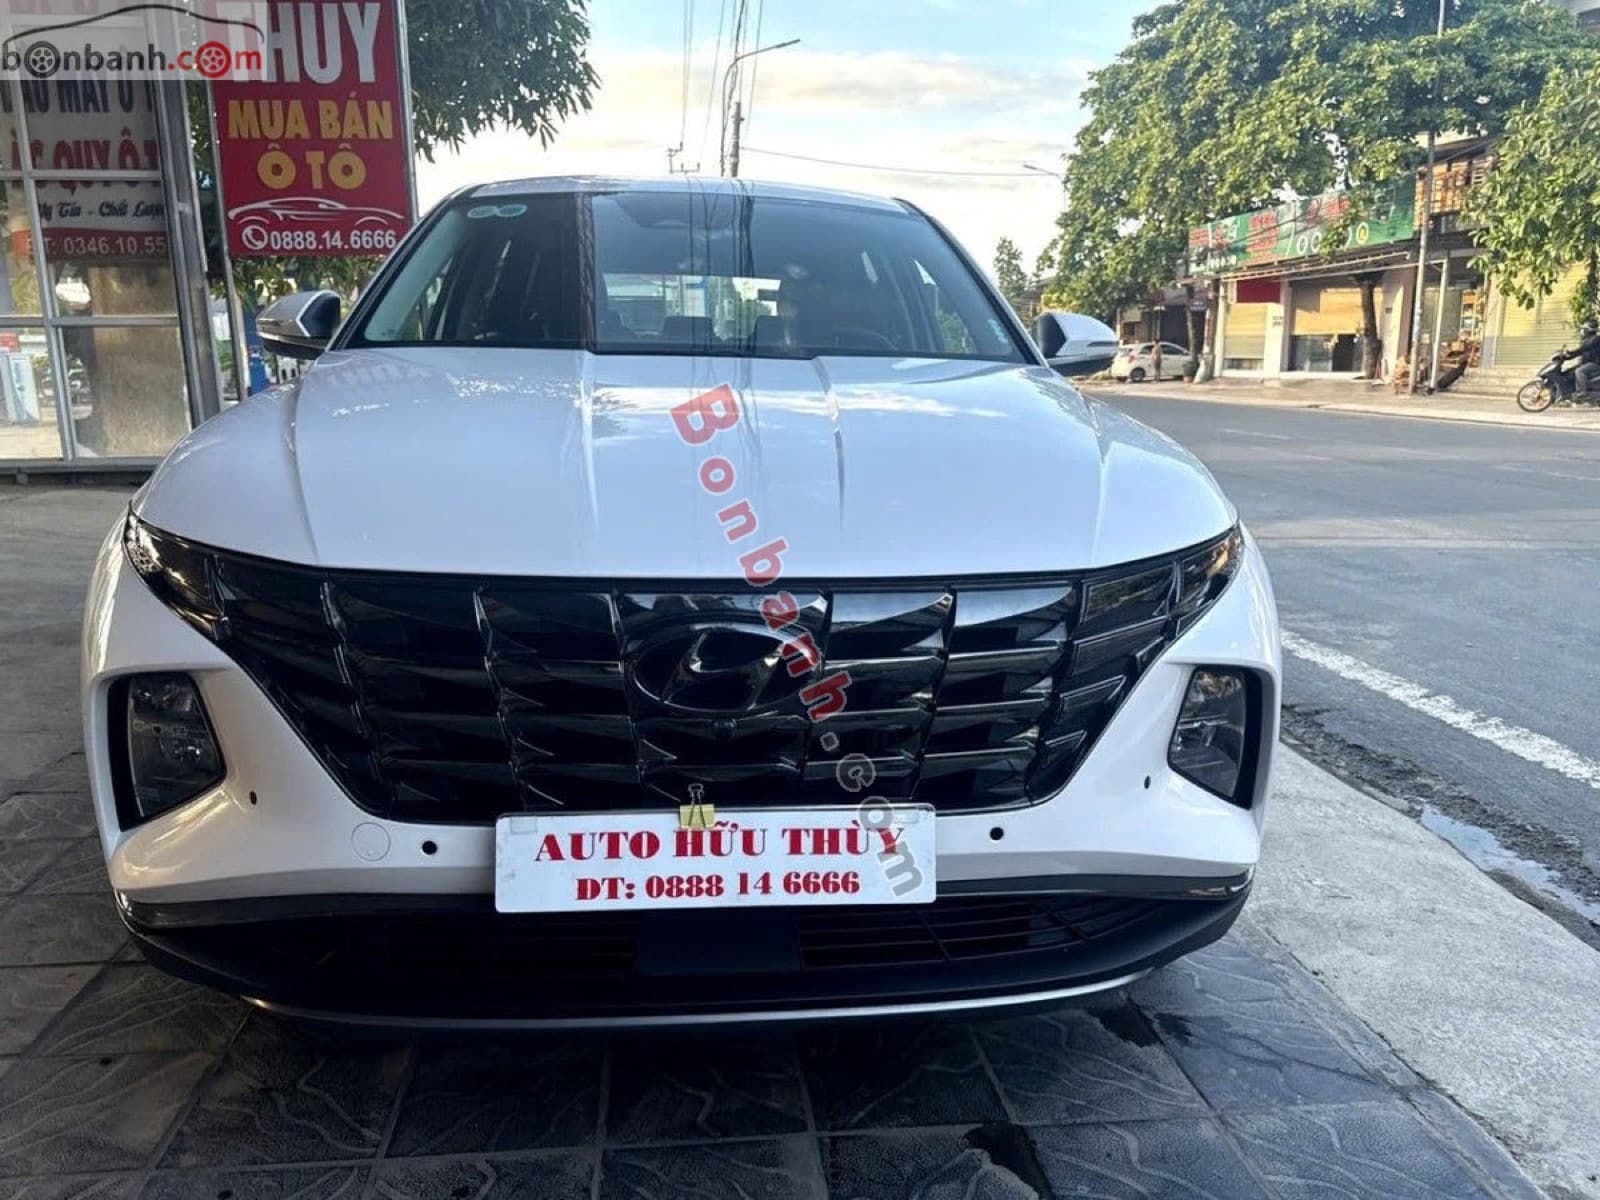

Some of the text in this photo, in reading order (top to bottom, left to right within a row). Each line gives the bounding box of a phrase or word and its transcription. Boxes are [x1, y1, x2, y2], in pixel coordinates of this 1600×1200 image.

[228, 91, 393, 139] MUA BÁN
[257, 143, 367, 190] Ô TÔ
[270, 229, 398, 250] 0888.14.6666
[534, 831, 660, 862] AUTO
[673, 820, 768, 857] HỮU
[645, 874, 725, 899] 0888
[738, 871, 772, 895] 14
[783, 871, 860, 895] 6666
